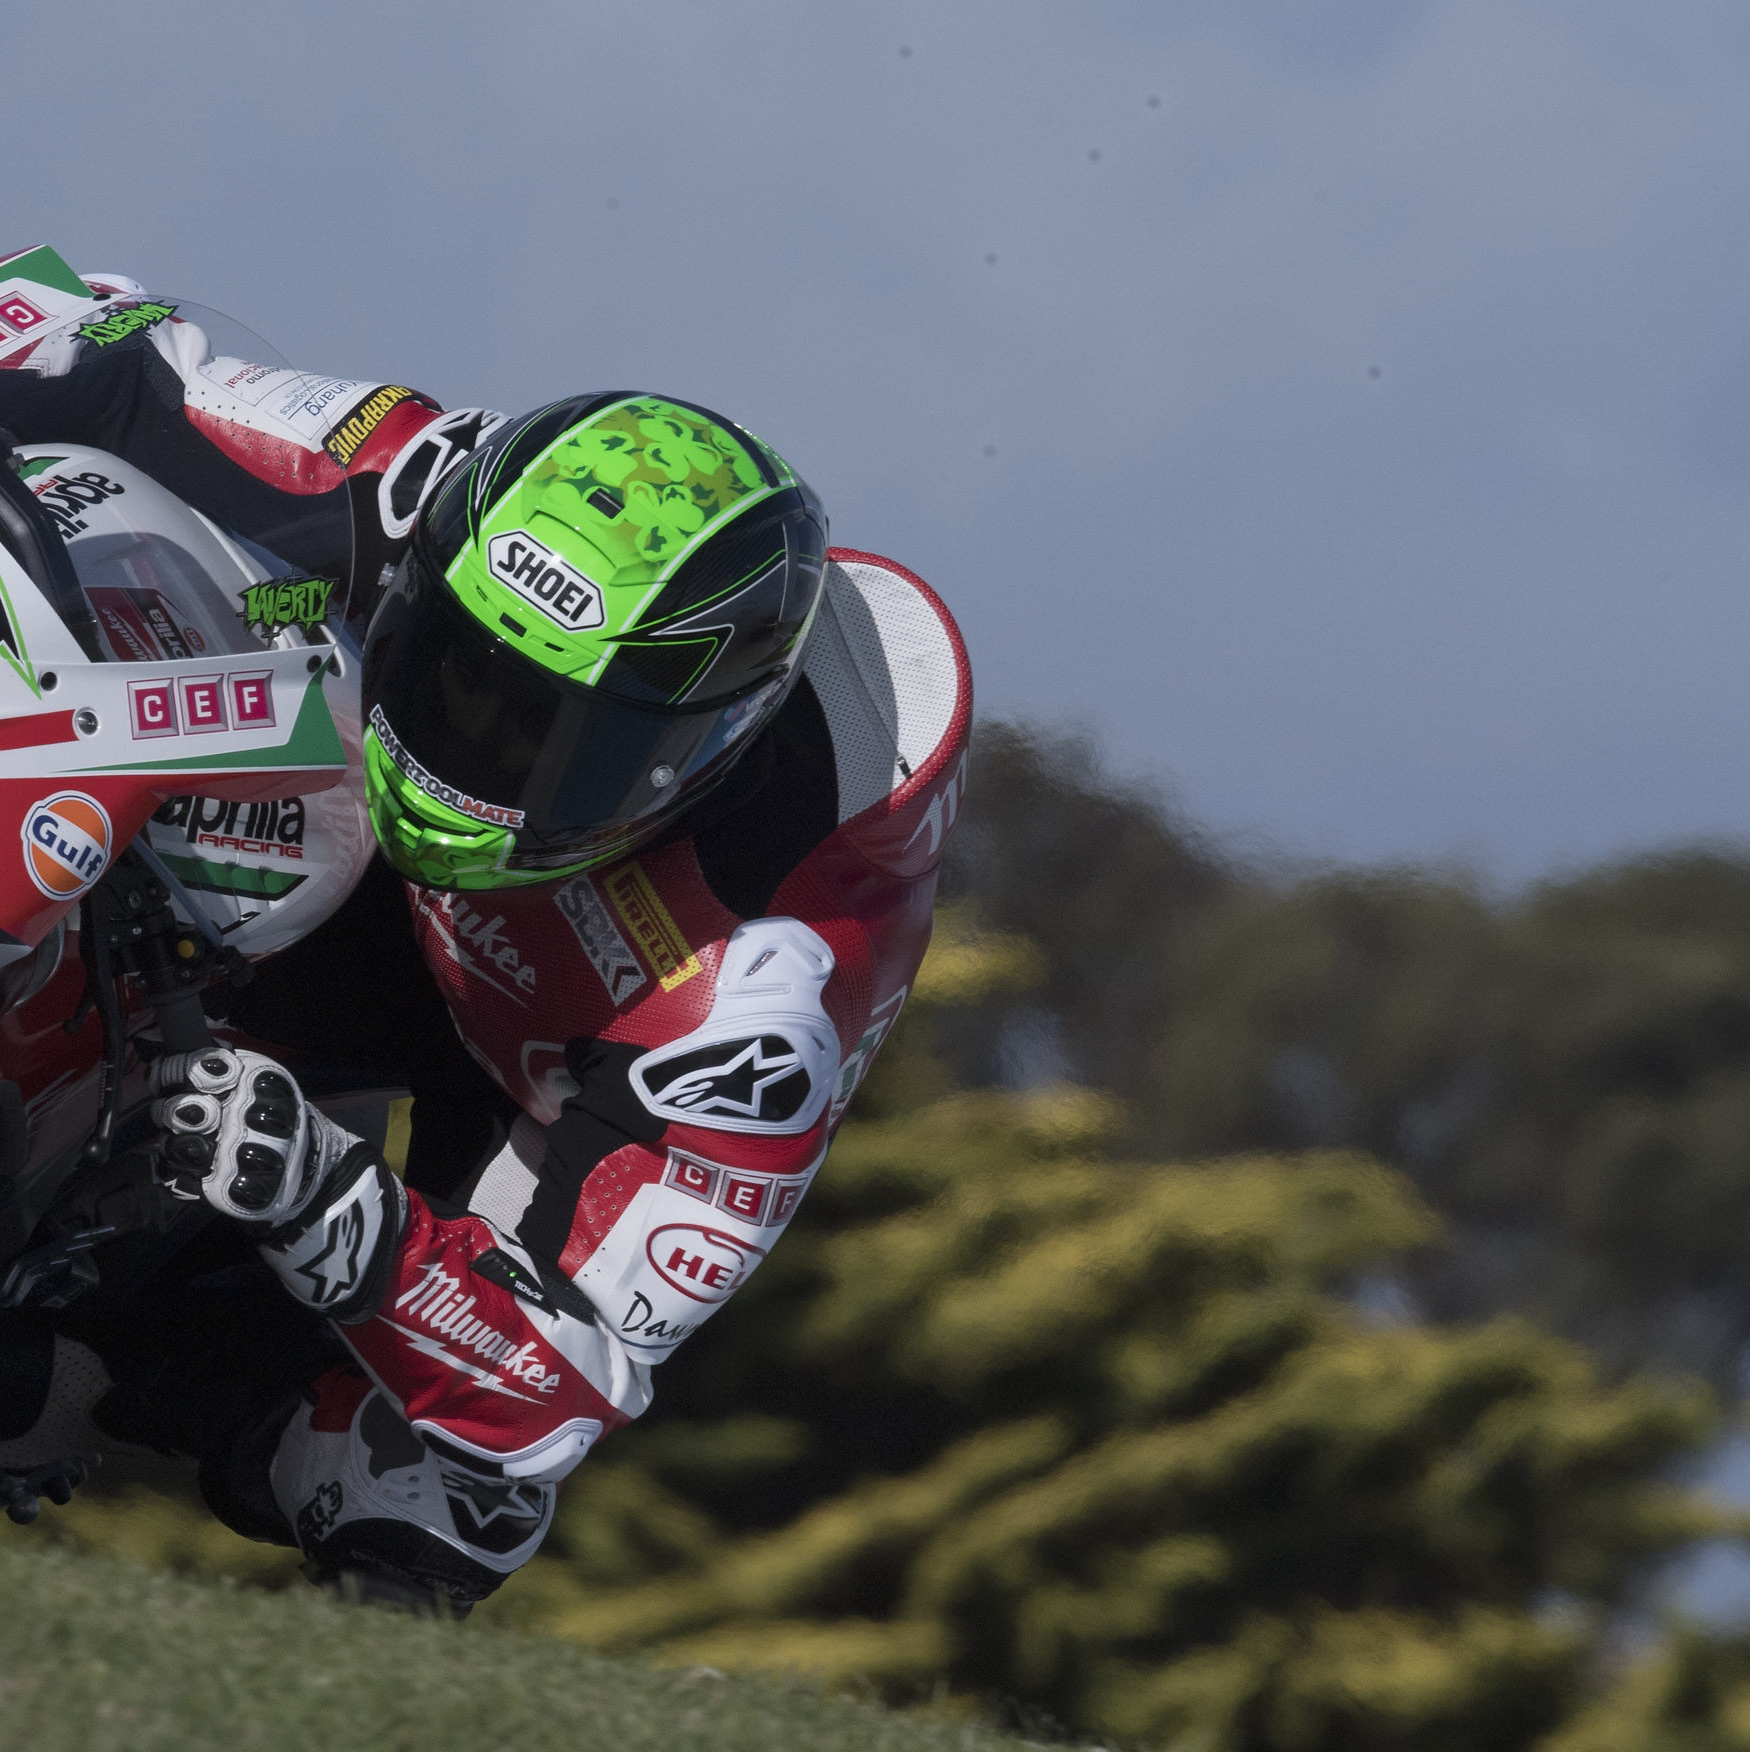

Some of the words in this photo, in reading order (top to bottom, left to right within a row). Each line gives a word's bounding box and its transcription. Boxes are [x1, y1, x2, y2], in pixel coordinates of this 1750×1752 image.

[496, 541, 594, 622] SHOEI
[143, 686, 258, 722] CEF
[32, 814, 102, 880] Gulf
[199, 834, 303, 859] RACING
[612, 871, 690, 979] PIRELLI
[684, 1164, 795, 1214] CEF
[395, 1262, 561, 1393] Milwaukee
